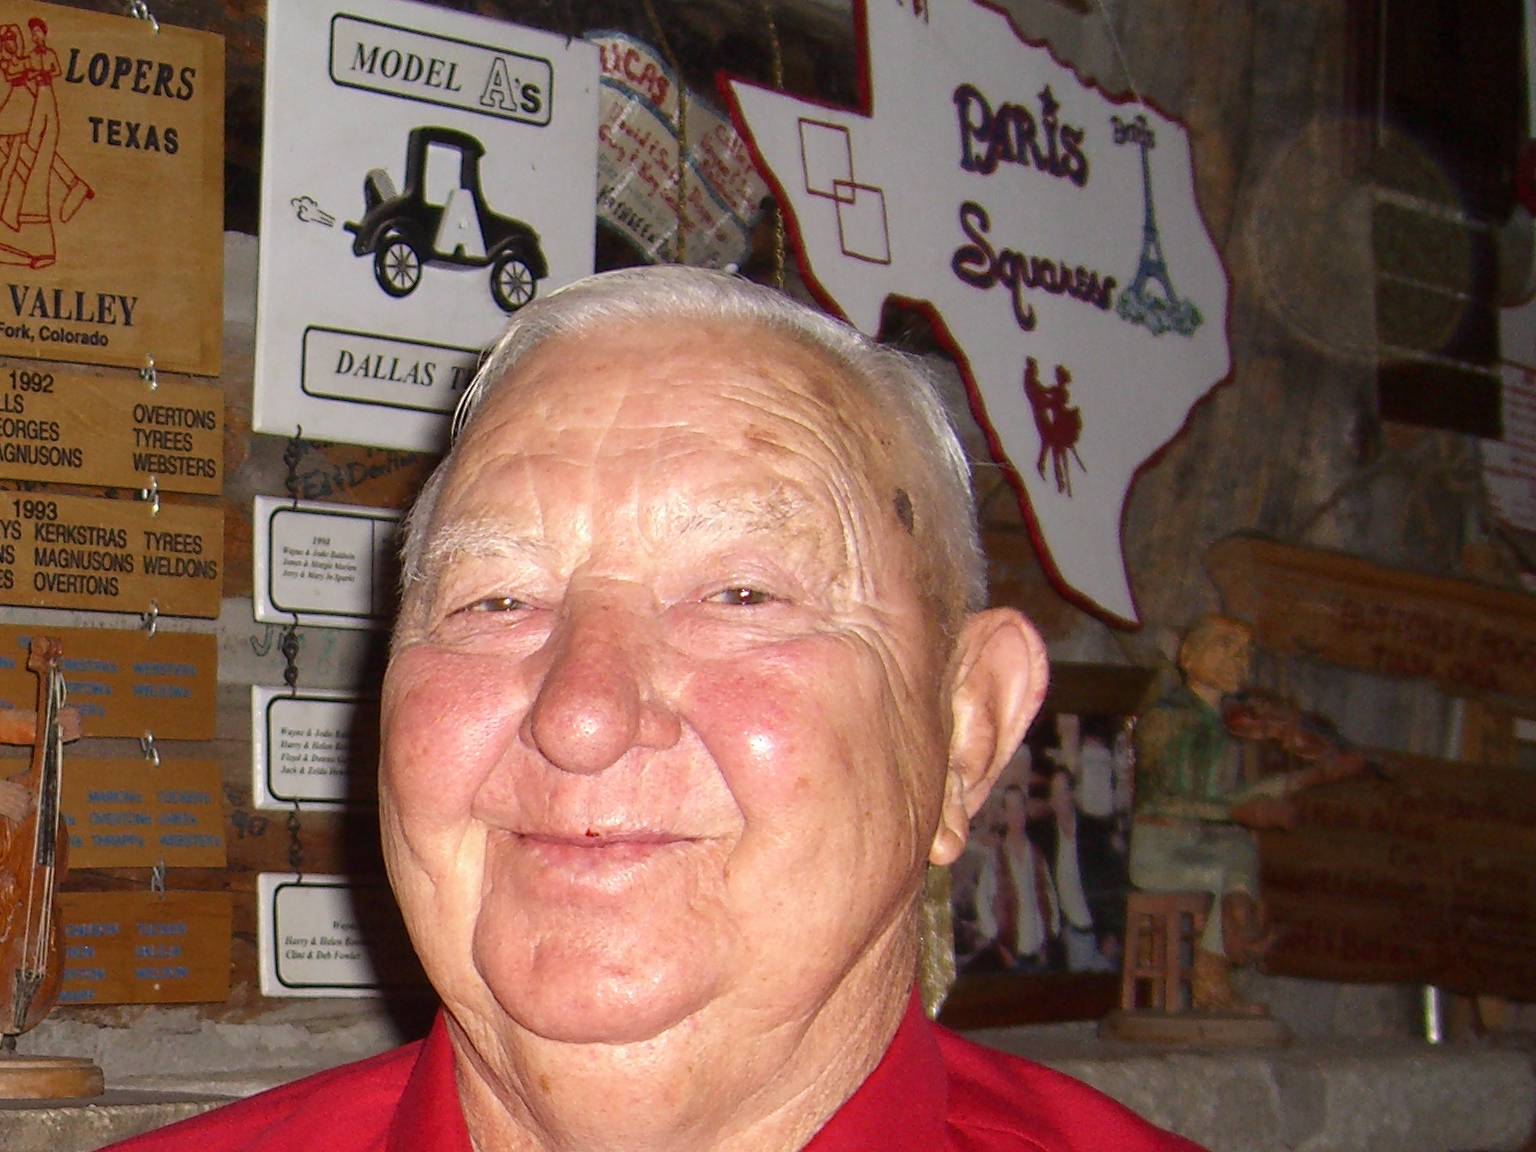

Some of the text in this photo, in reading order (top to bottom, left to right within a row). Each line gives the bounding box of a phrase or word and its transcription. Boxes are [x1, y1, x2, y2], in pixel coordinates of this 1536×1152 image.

[65, 48, 196, 100] LOPERS
[351, 42, 462, 92] MODEL
[89, 116, 179, 154] TEXAS
[7, 284, 138, 327] VALLEY
[39, 326, 109, 346] Colorado
[335, 350, 436, 386] DALLAS
[9, 371, 54, 393] 1992
[133, 404, 216, 430] OVERTONS
[133, 428, 193, 451] TYREES
[133, 453, 216, 478] WEBSTERS
[13, 499, 57, 521] 1993
[34, 523, 127, 548] KERKSTRAS
[143, 531, 202, 554] TYREES
[34, 547, 134, 573] MAGNUSONS
[143, 555, 217, 579] WELDONS
[33, 572, 119, 596] OVERTONS
